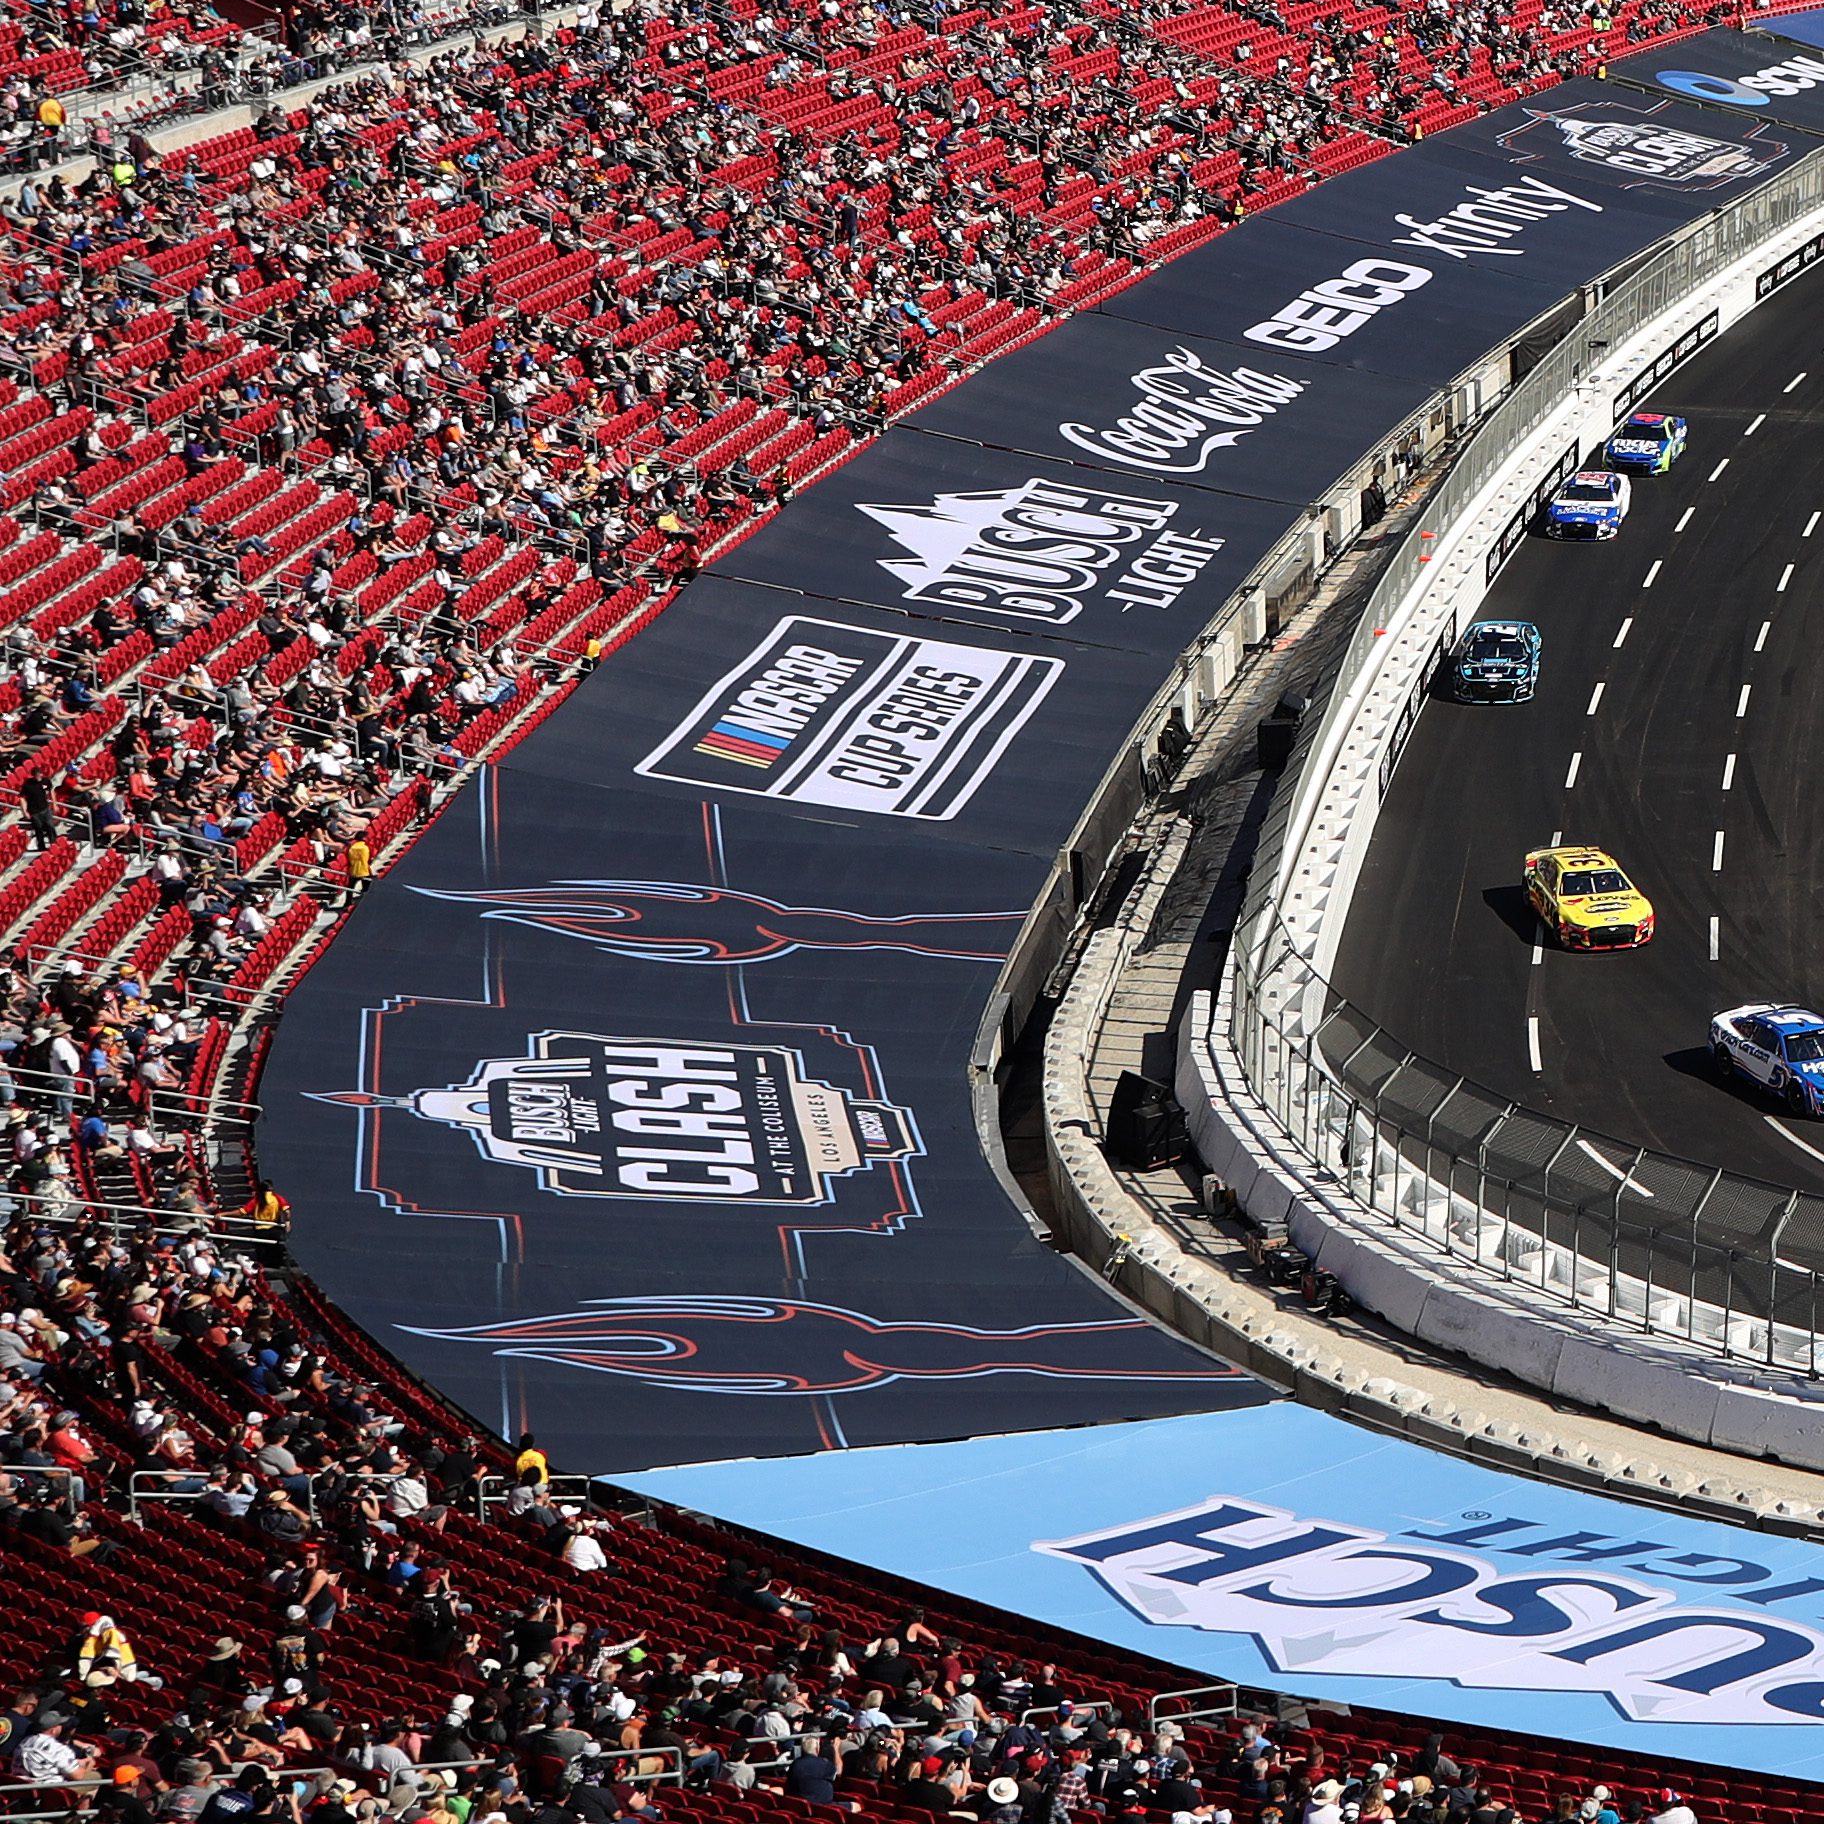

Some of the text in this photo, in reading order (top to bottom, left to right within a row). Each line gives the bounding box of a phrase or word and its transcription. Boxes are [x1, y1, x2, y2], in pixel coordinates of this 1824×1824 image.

[1606, 131, 1722, 175] CLASH
[1394, 175, 1603, 259] xfinity
[1244, 258, 1432, 353] GEICO
[1059, 344, 1303, 473] Coca-Cola
[903, 478, 1178, 625] BUSCH
[1106, 529, 1225, 613] LIGHT
[721, 645, 864, 739] NASCAR
[827, 664, 983, 789] CUP SERIES
[508, 1080, 576, 1143] BUSCH
[604, 1046, 760, 1195] CLASH
[755, 1076, 796, 1176] AT THE COLISEUM
[807, 1093, 841, 1162] LOS ANGELES
